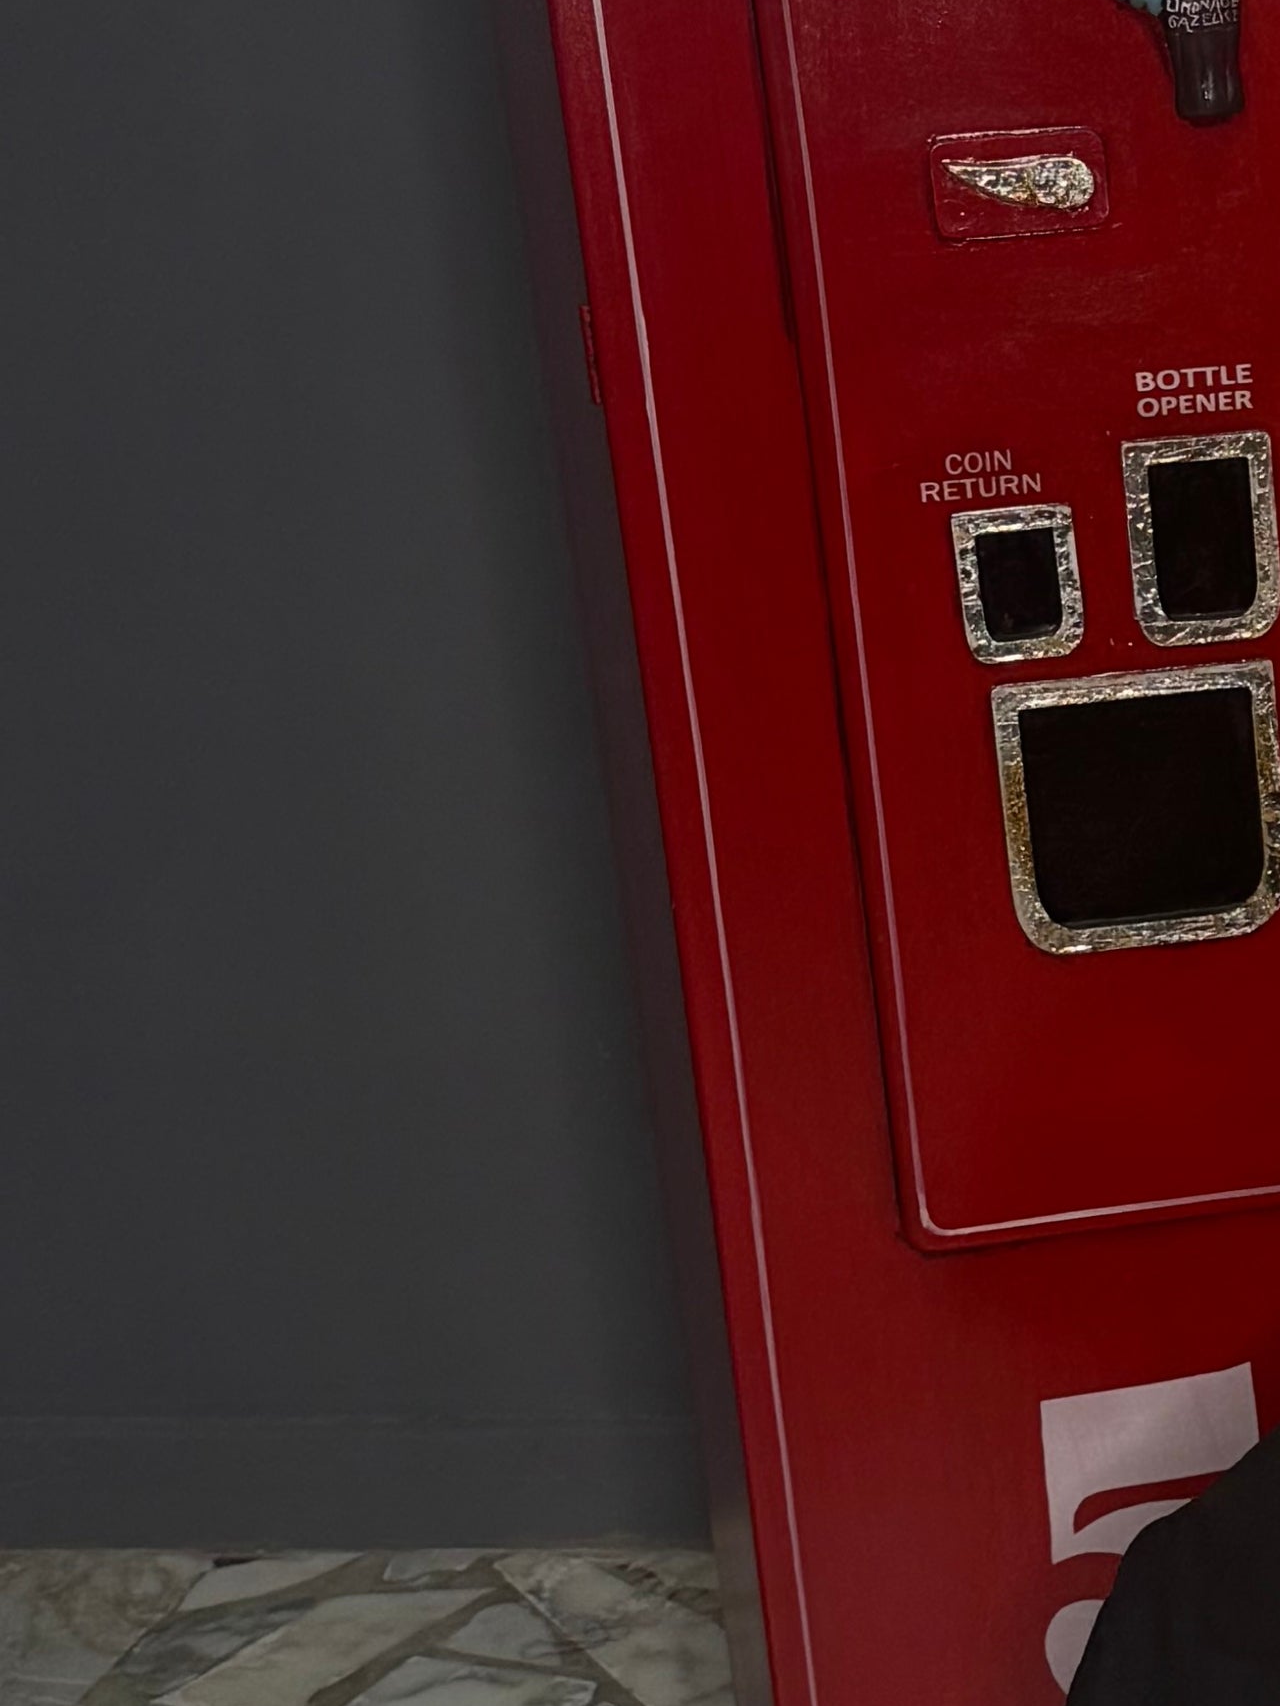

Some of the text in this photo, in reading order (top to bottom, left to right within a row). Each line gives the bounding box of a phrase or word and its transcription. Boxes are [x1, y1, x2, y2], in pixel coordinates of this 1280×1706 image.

[1134, 363, 1254, 393] BOTTLE
[1136, 389, 1254, 419] OPENER
[944, 449, 1013, 477] COIN
[919, 473, 1042, 504] RETURN
